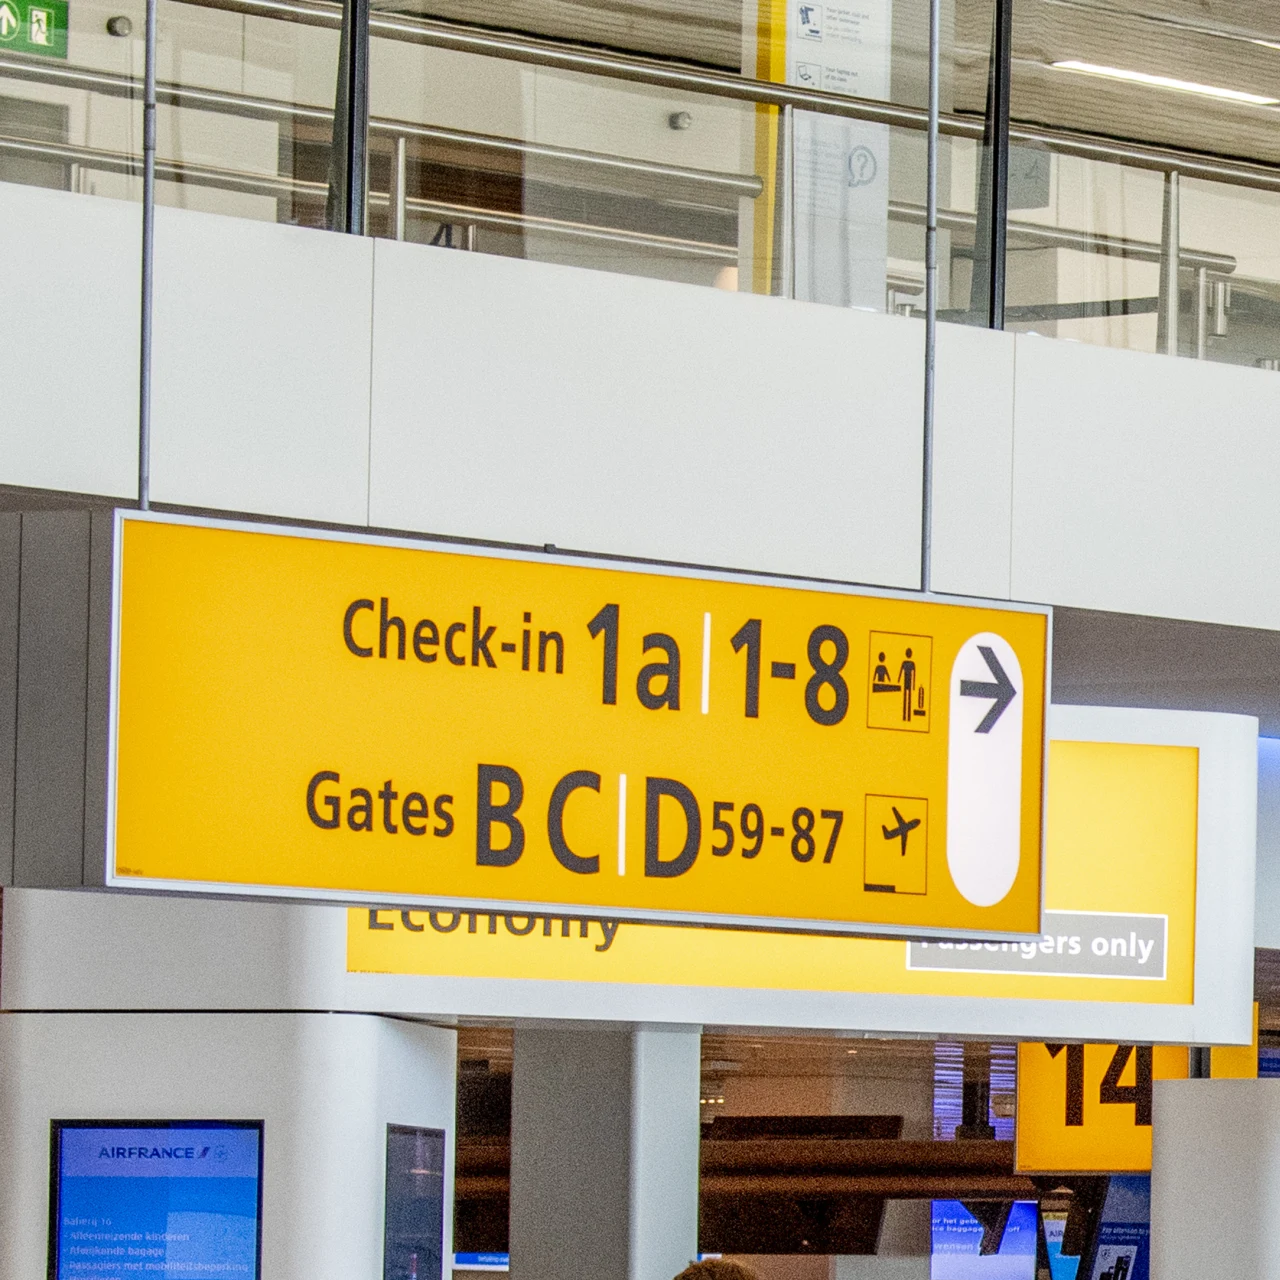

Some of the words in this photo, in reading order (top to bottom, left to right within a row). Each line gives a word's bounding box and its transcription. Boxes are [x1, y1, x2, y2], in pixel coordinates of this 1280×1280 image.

[342, 597, 564, 674] Check-in
[586, 603, 681, 710] 1a
[730, 618, 849, 726] 1-8
[306, 770, 454, 837] Gates
[476, 763, 526, 867] B
[547, 769, 601, 874] C
[1091, 931, 1154, 963] only
[1043, 1042, 1152, 1126] 14
[98, 1146, 194, 1159] AIRFRANCE
